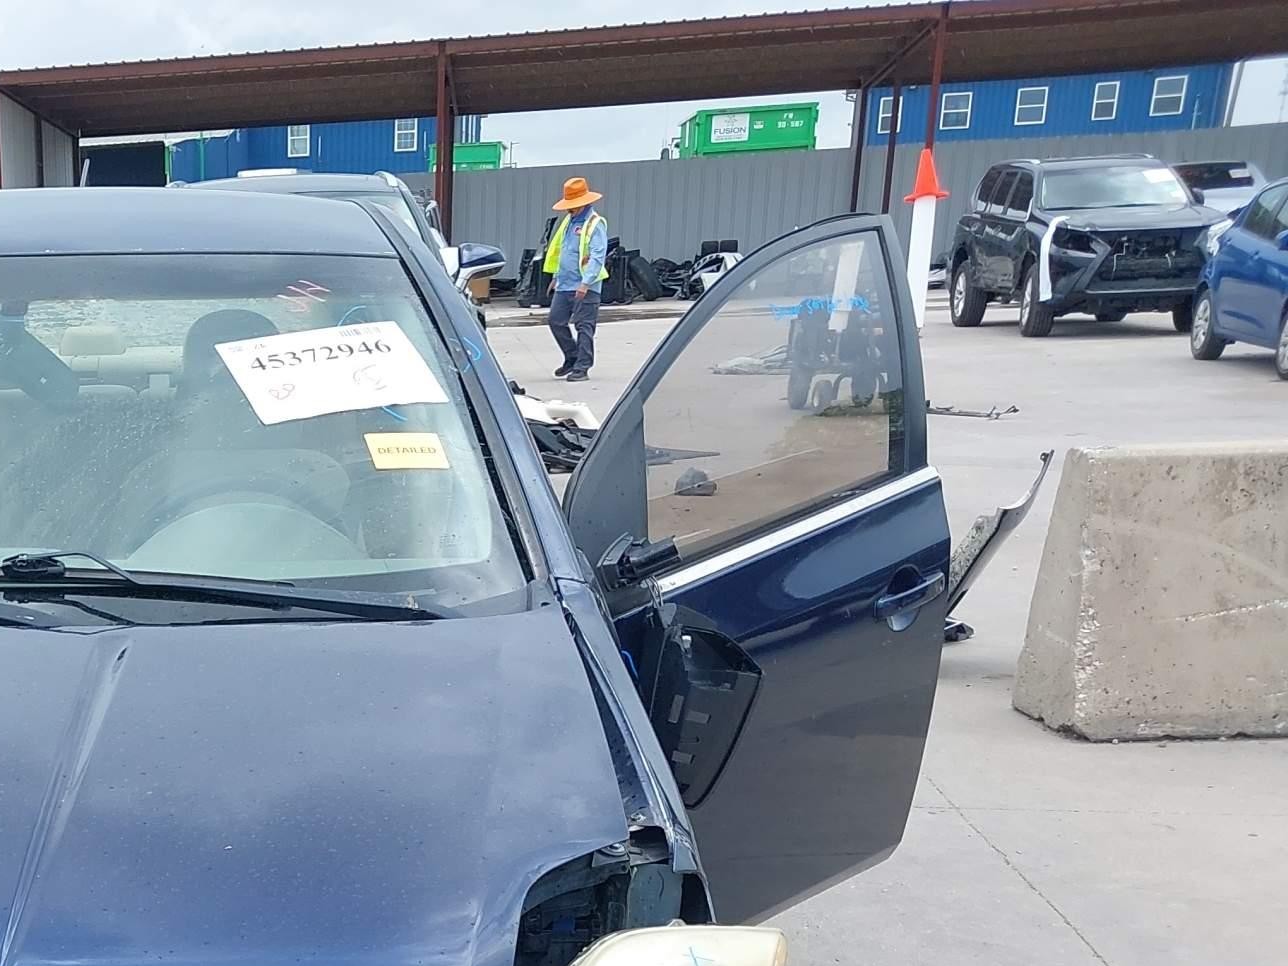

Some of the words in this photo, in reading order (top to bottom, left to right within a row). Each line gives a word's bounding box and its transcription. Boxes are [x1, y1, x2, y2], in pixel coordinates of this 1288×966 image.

[713, 126, 747, 136] FUSION
[250, 338, 393, 371] 45372946
[377, 446, 438, 456] DETAILED
